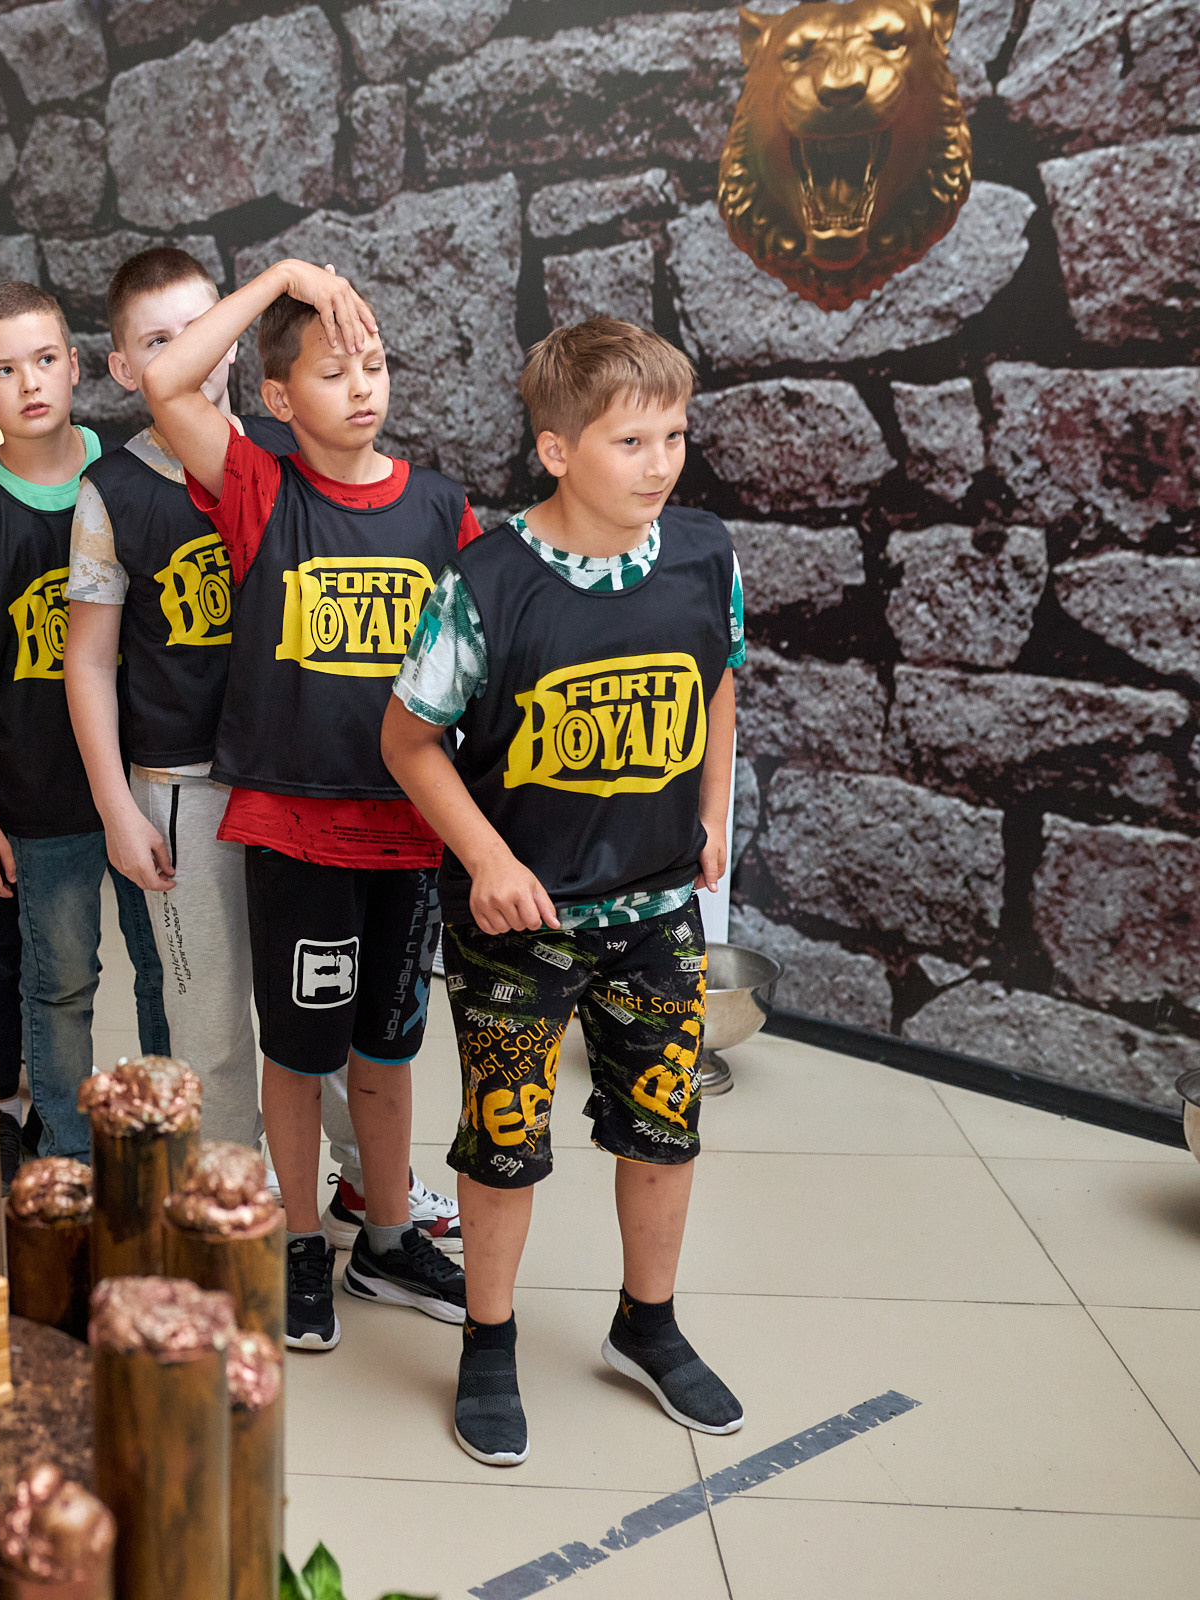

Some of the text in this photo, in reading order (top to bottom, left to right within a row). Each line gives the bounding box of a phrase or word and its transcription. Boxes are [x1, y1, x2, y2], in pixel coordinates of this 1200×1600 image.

[321, 571, 409, 595] FORT
[566, 671, 674, 706] FORT
[503, 668, 707, 789] BOYARD
[395, 957, 414, 1004] FIGHT
[607, 989, 644, 1012] Just
[650, 996, 693, 1015] Sour
[382, 1008, 401, 1042] FOR
[500, 1016, 550, 1060] Sour
[501, 1055, 536, 1087] Just
